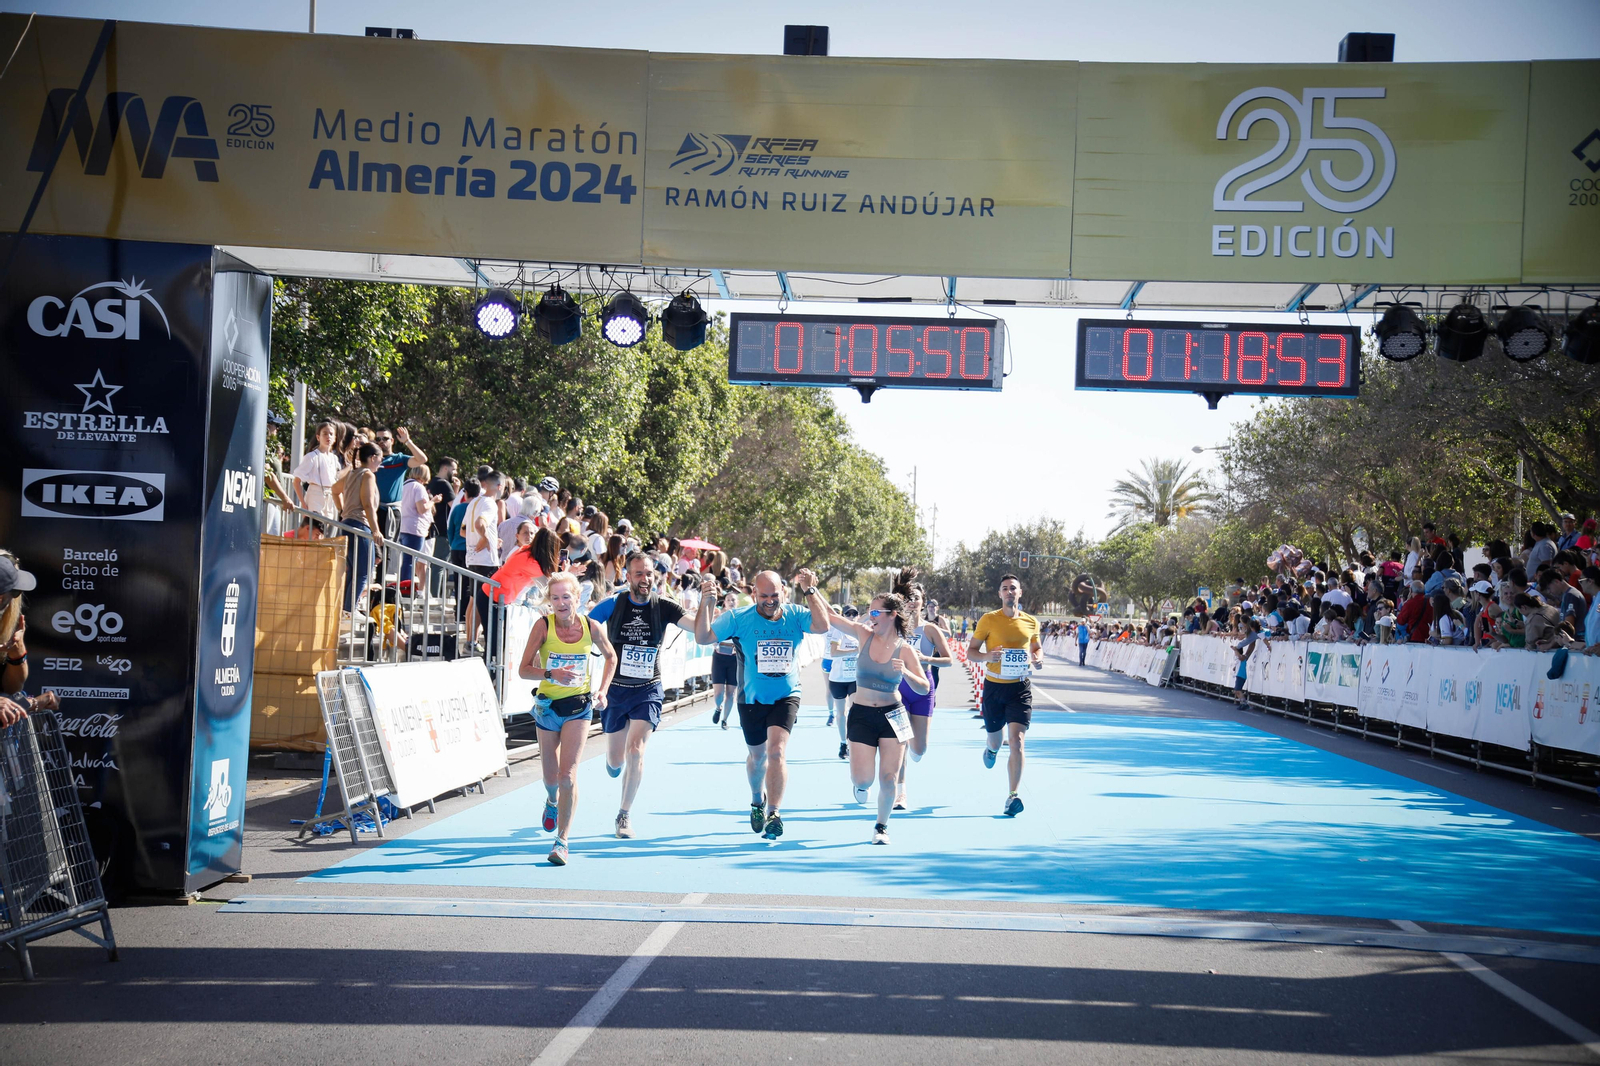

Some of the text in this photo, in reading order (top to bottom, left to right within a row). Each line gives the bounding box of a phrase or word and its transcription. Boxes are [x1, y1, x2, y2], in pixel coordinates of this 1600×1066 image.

[227, 103, 276, 138] 25
[312, 107, 638, 155] Medio Maratón
[226, 138, 275, 151] EDICIÓN
[751, 137, 819, 153] RFEA
[1213, 86, 1398, 214] 25
[744, 154, 811, 167] SERIES
[308, 149, 638, 205] Almería 2024
[738, 167, 849, 179] RUTA RUNNING
[665, 185, 996, 218] RAMÓN RUIZ ANDÚJAR
[1568, 193, 1600, 206] 200
[1211, 218, 1395, 258] EDICIÓN
[27, 296, 141, 340] CASI
[1121, 327, 1348, 388] 01:18:53
[222, 358, 261, 384] COOPERACIÓN
[23, 411, 170, 434] ESTRELLA
[57, 431, 137, 443] DE LEVANTE
[42, 483, 149, 507] IKEA
[63, 548, 118, 562] Barceló
[62, 563, 119, 577] Cabo de
[62, 577, 95, 591] Gata
[51, 603, 124, 642] ego
[626, 652, 653, 663] 5910
[762, 647, 790, 656] 5907
[1005, 654, 1028, 663] 5865
[214, 663, 241, 685] ALMERÍA
[56, 688, 75, 697] Voz
[76, 689, 88, 697] de
[88, 690, 128, 699] Almería
